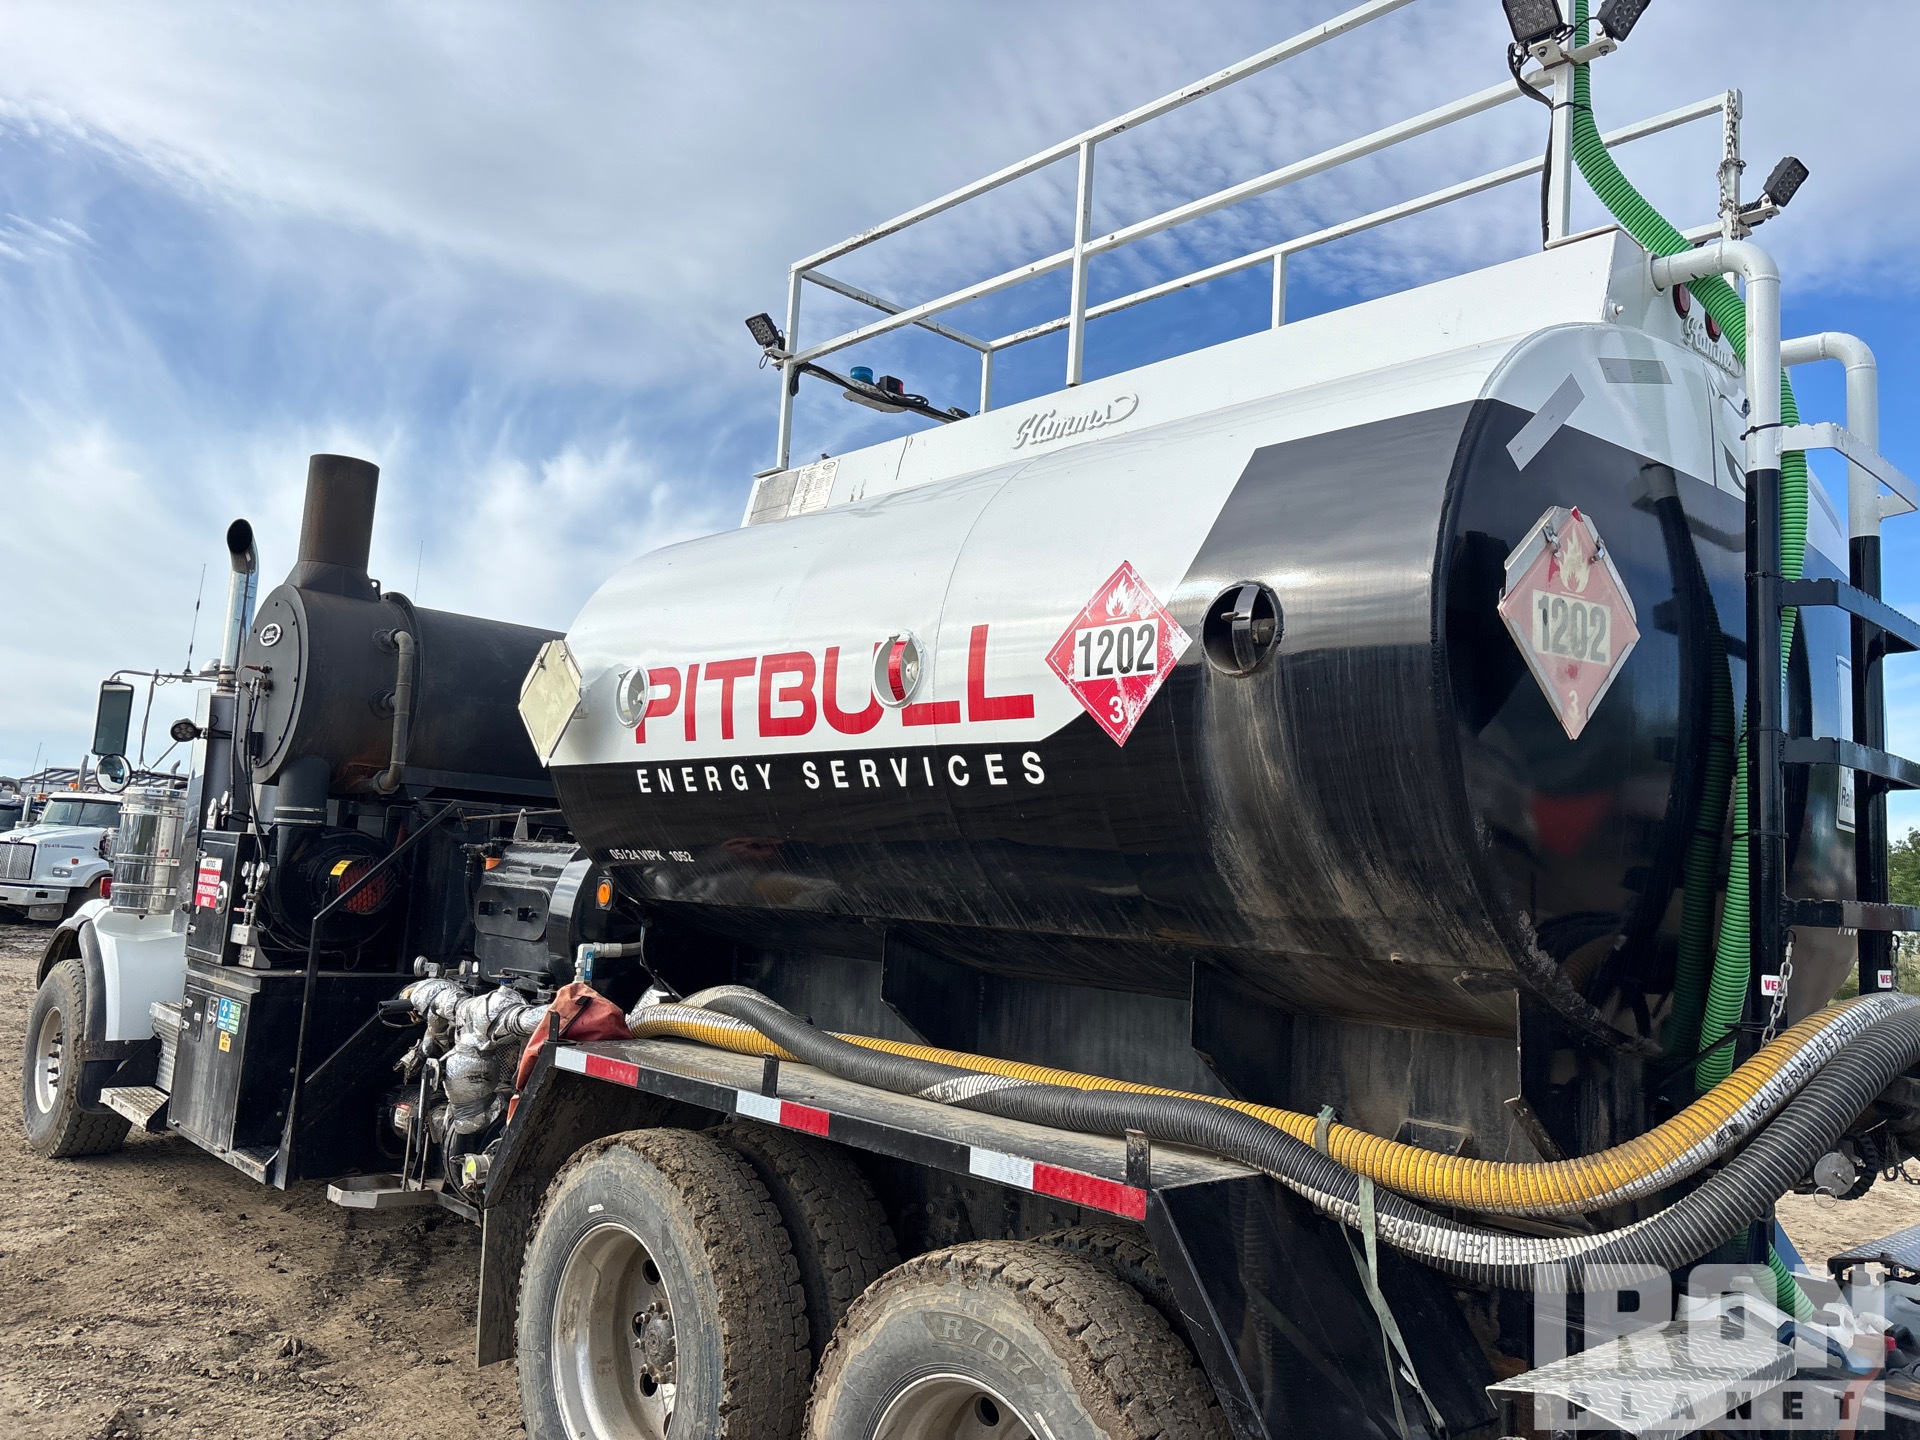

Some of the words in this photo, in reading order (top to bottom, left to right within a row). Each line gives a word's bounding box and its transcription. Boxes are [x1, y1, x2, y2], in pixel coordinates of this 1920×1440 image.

[1078, 623, 1156, 678] 1202
[1537, 595, 1607, 663] 1202
[635, 624, 1036, 744] PITBULL
[1109, 696, 1124, 724] 3
[1568, 690, 1580, 725] 3
[637, 763, 772, 794] ENERGY
[804, 751, 1046, 790] SERVICES
[609, 848, 640, 860] 05/24
[668, 850, 695, 862] 1052
[1748, 1049, 1820, 1122] WOLVERINE
[940, 1315, 1033, 1377] R707
